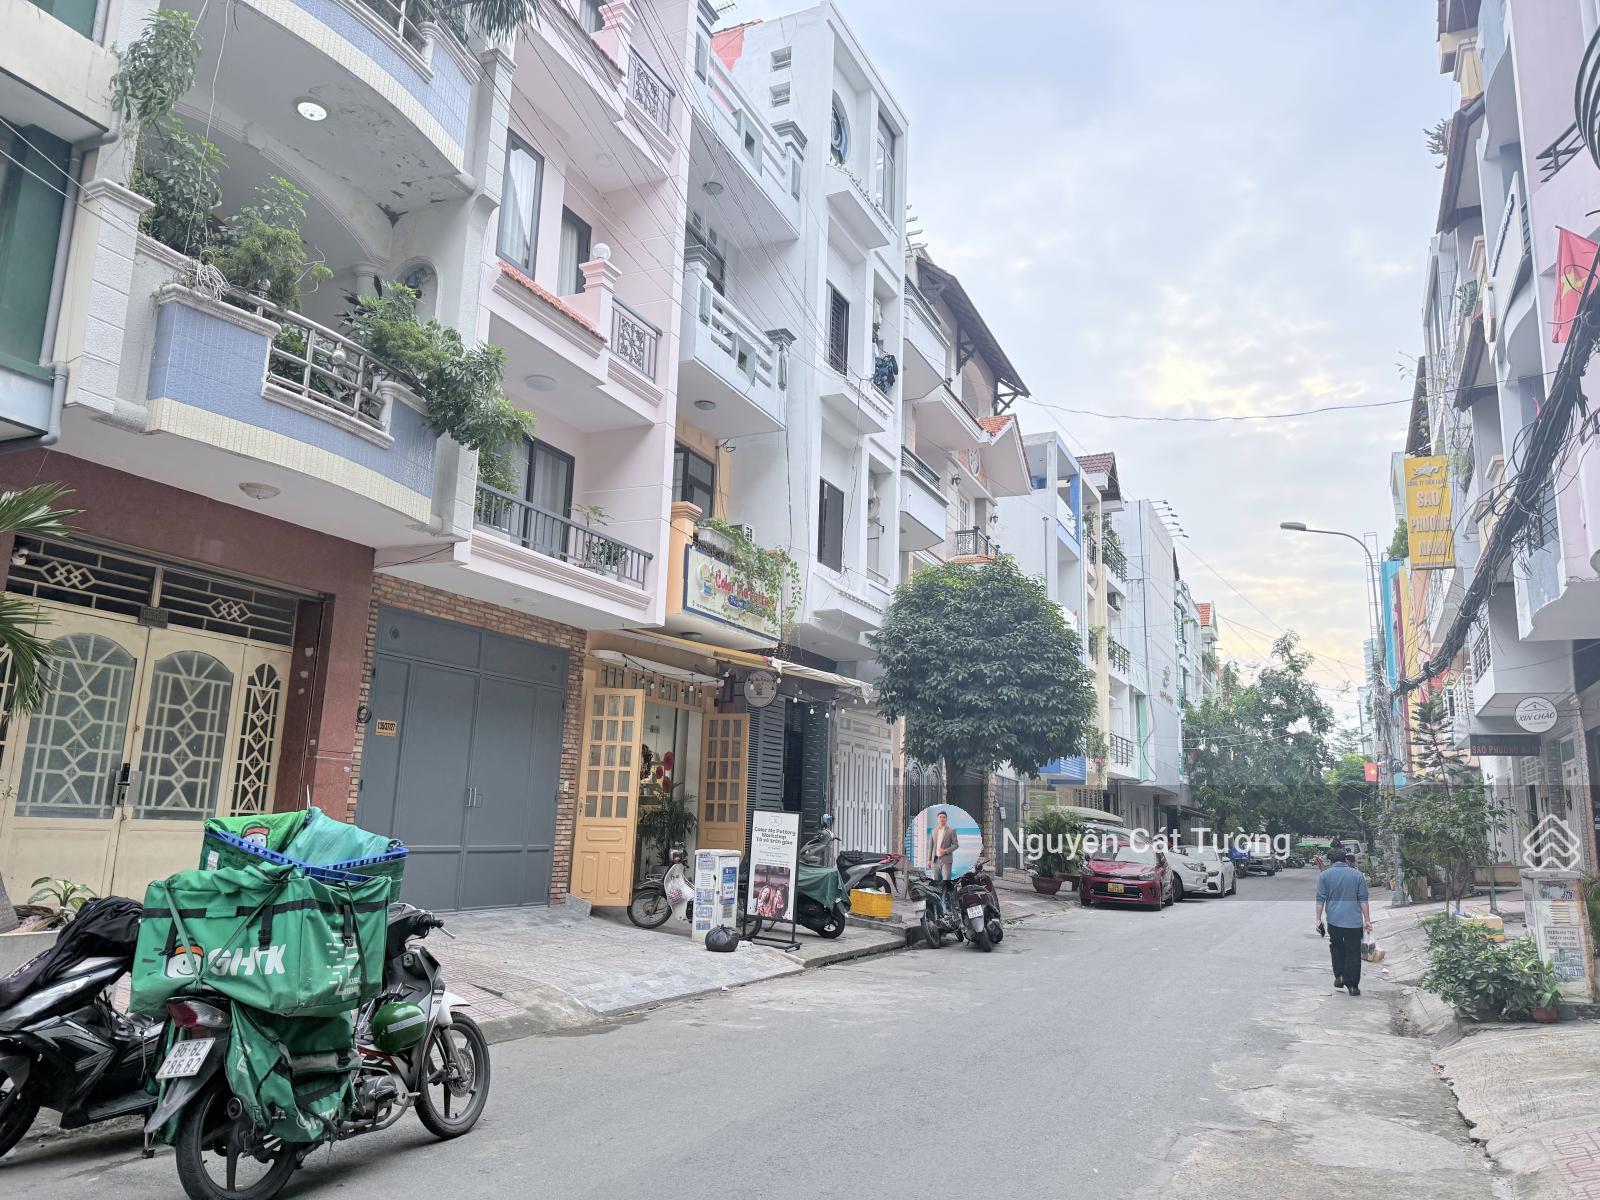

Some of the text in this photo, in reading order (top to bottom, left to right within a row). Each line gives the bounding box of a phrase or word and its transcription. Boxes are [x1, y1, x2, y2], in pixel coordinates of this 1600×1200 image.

[1416, 490, 1440, 507] SAO
[1472, 745, 1486, 754] SAO
[207, 944, 286, 977] GHTK
[160, 1057, 201, 1075] 286.82
